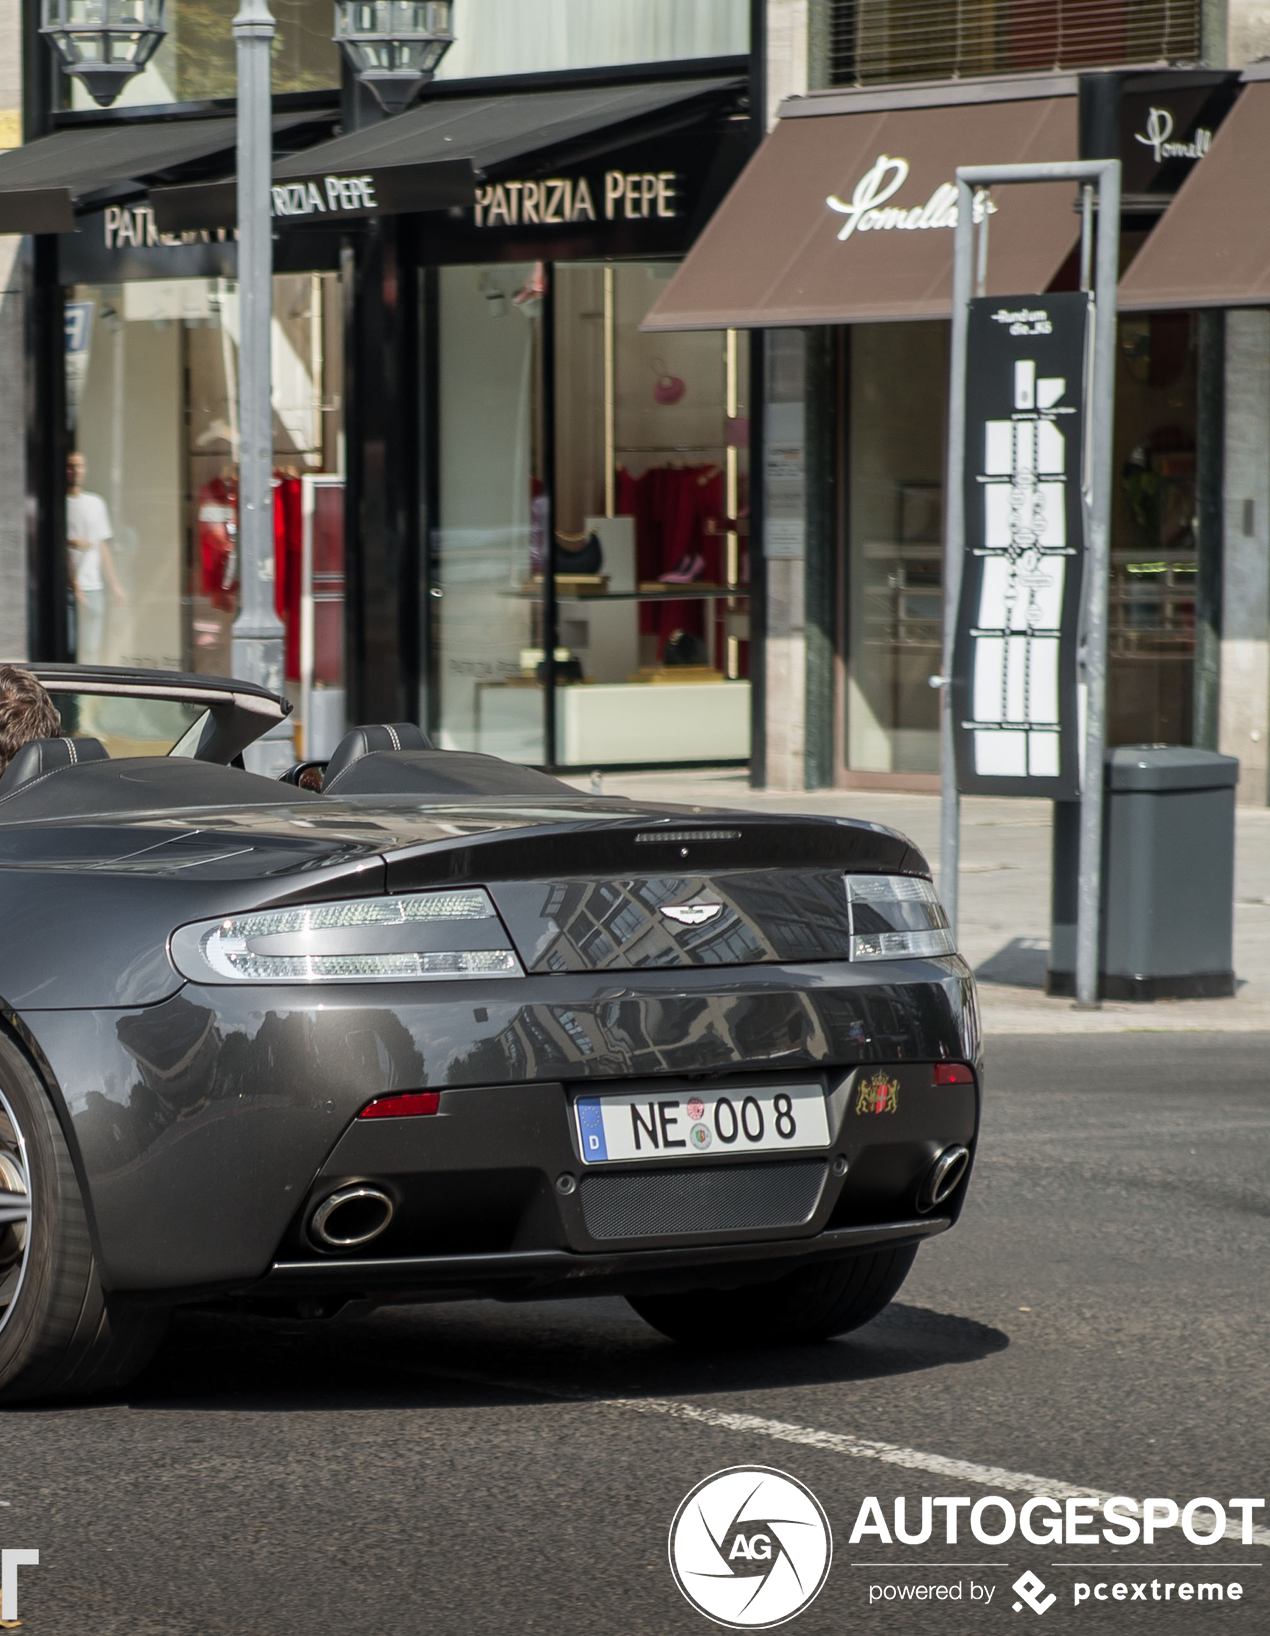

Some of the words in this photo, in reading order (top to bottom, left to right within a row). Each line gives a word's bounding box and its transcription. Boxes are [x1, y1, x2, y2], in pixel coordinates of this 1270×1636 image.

[324, 175, 379, 211] PEPE
[474, 177, 596, 227] PATRIZIA
[605, 169, 676, 221] PEPE
[589, 1135, 599, 1150] D
[630, 1100, 687, 1150] NE
